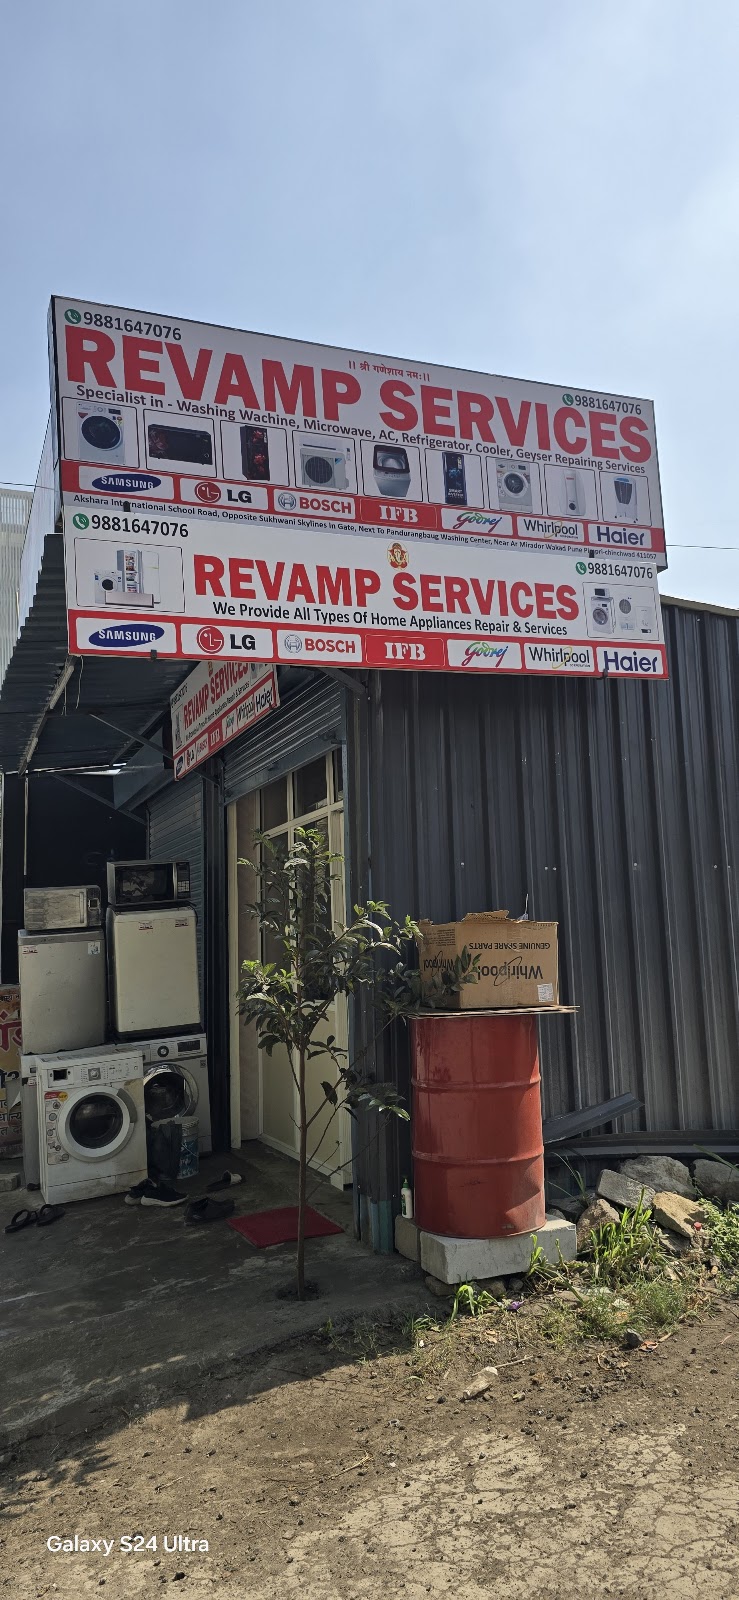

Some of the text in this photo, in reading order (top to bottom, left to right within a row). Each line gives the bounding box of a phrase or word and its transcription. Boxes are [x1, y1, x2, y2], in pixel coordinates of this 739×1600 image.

[83, 311, 182, 341] 9881647076
[372, 363, 403, 377] गणेशाय
[65, 325, 651, 463] REVAMP SERVICES
[574, 394, 642, 415] 9881647076
[76, 384, 146, 406] Specialist
[150, 396, 163, 408] in
[176, 400, 236, 420] Washing
[238, 409, 300, 430] Wachine,
[303, 419, 376, 440] Microwave,
[379, 430, 399, 443] AC,
[402, 433, 473, 453] Refrigerator,
[475, 443, 513, 458] Cooler,
[516, 449, 552, 463] Geyser
[555, 453, 603, 470] Repairing
[605, 460, 645, 474] Services
[101, 476, 154, 489] SAMSUNG
[227, 489, 252, 503] LG
[299, 497, 351, 514] BOSCH
[74, 494, 108, 505] Akshara
[168, 505, 195, 515] School
[197, 509, 220, 518] Road,
[222, 511, 257, 521] Opposite
[259, 515, 296, 525] Sukhwani
[297, 519, 327, 529] Skylines
[338, 523, 357, 532] Gate,
[358, 526, 376, 534] Next
[377, 527, 385, 535] To
[440, 534, 468, 543] Washing
[494, 539, 509, 547] Near
[520, 541, 544, 549] Mirador
[379, 505, 418, 523] IFB
[453, 510, 502, 533] Godrej
[91, 515, 189, 538] 9881647076
[524, 519, 578, 537] Whirlpool
[597, 526, 644, 545] Haier
[587, 562, 653, 579] 9881647076
[193, 554, 580, 621] REVAMP SERVICES
[212, 601, 567, 636] We Provide All Types Of Home Appliances Repair & Services
[99, 629, 156, 642] SAMSUNG
[230, 634, 256, 650] LG
[305, 638, 356, 653] BOSCH
[385, 642, 426, 661] IFB
[461, 641, 508, 667] Godrej
[529, 646, 590, 666] Whirlpool
[603, 650, 657, 672] Haier
[183, 683, 209, 731] REVAMP
[469, 942, 551, 950] GENUINE SPARE PARTS
[478, 962, 544, 981] Whirlpool
